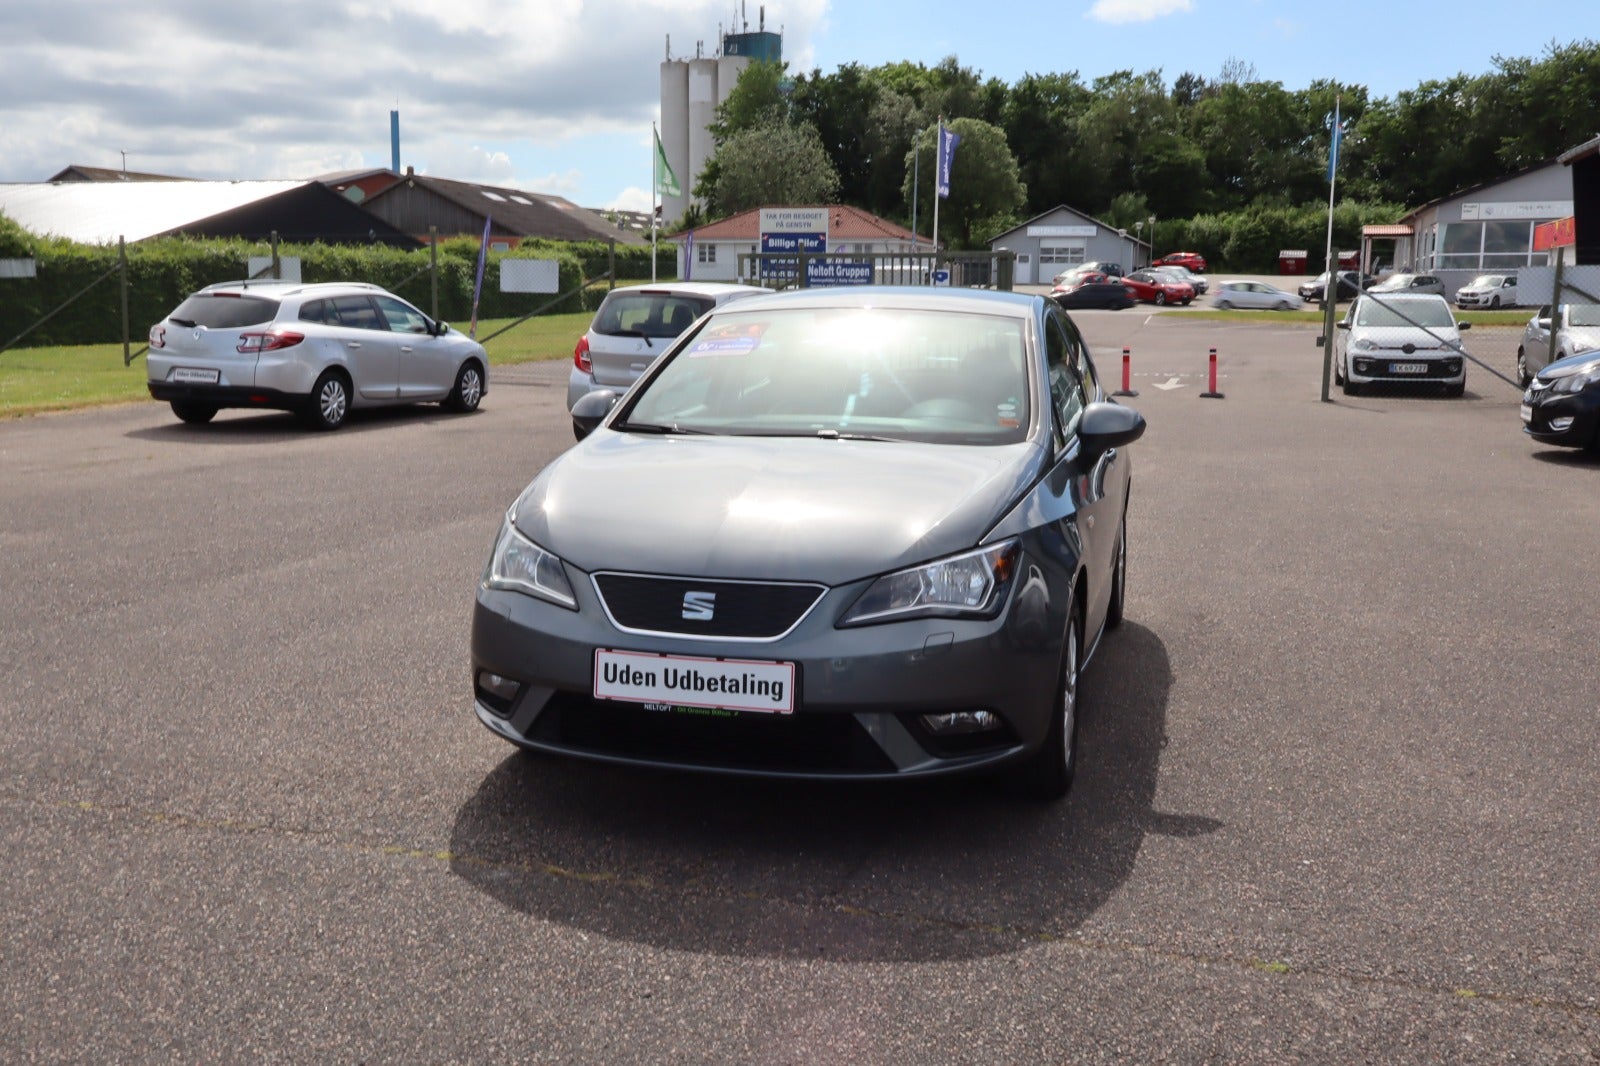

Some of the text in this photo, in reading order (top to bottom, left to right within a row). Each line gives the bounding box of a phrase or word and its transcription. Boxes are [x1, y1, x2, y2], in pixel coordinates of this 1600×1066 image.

[768, 238, 796, 249] Billige
[807, 265, 835, 277] Neltoft
[836, 265, 870, 278] Gruppen
[603, 662, 784, 702] Uden Udbetaling
[644, 703, 672, 712] NELTOFT
